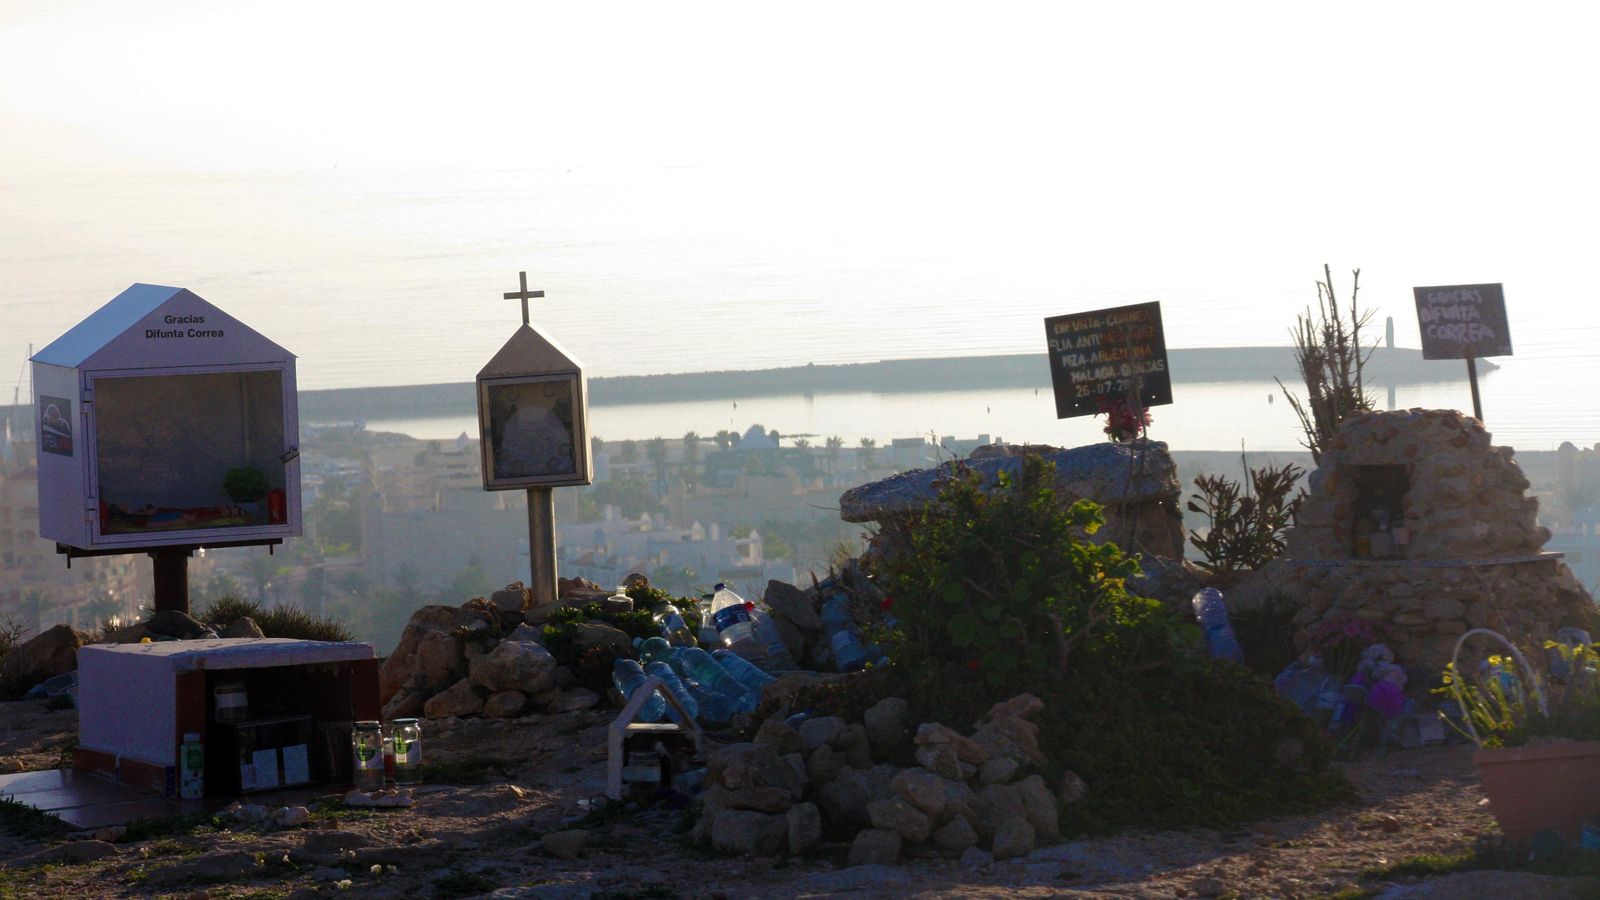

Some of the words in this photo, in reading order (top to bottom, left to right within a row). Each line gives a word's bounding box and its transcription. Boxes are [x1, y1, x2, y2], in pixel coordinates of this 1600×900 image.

[164, 314, 205, 324] Gracias
[145, 329, 184, 338] Difunta
[187, 328, 225, 338] Correa
